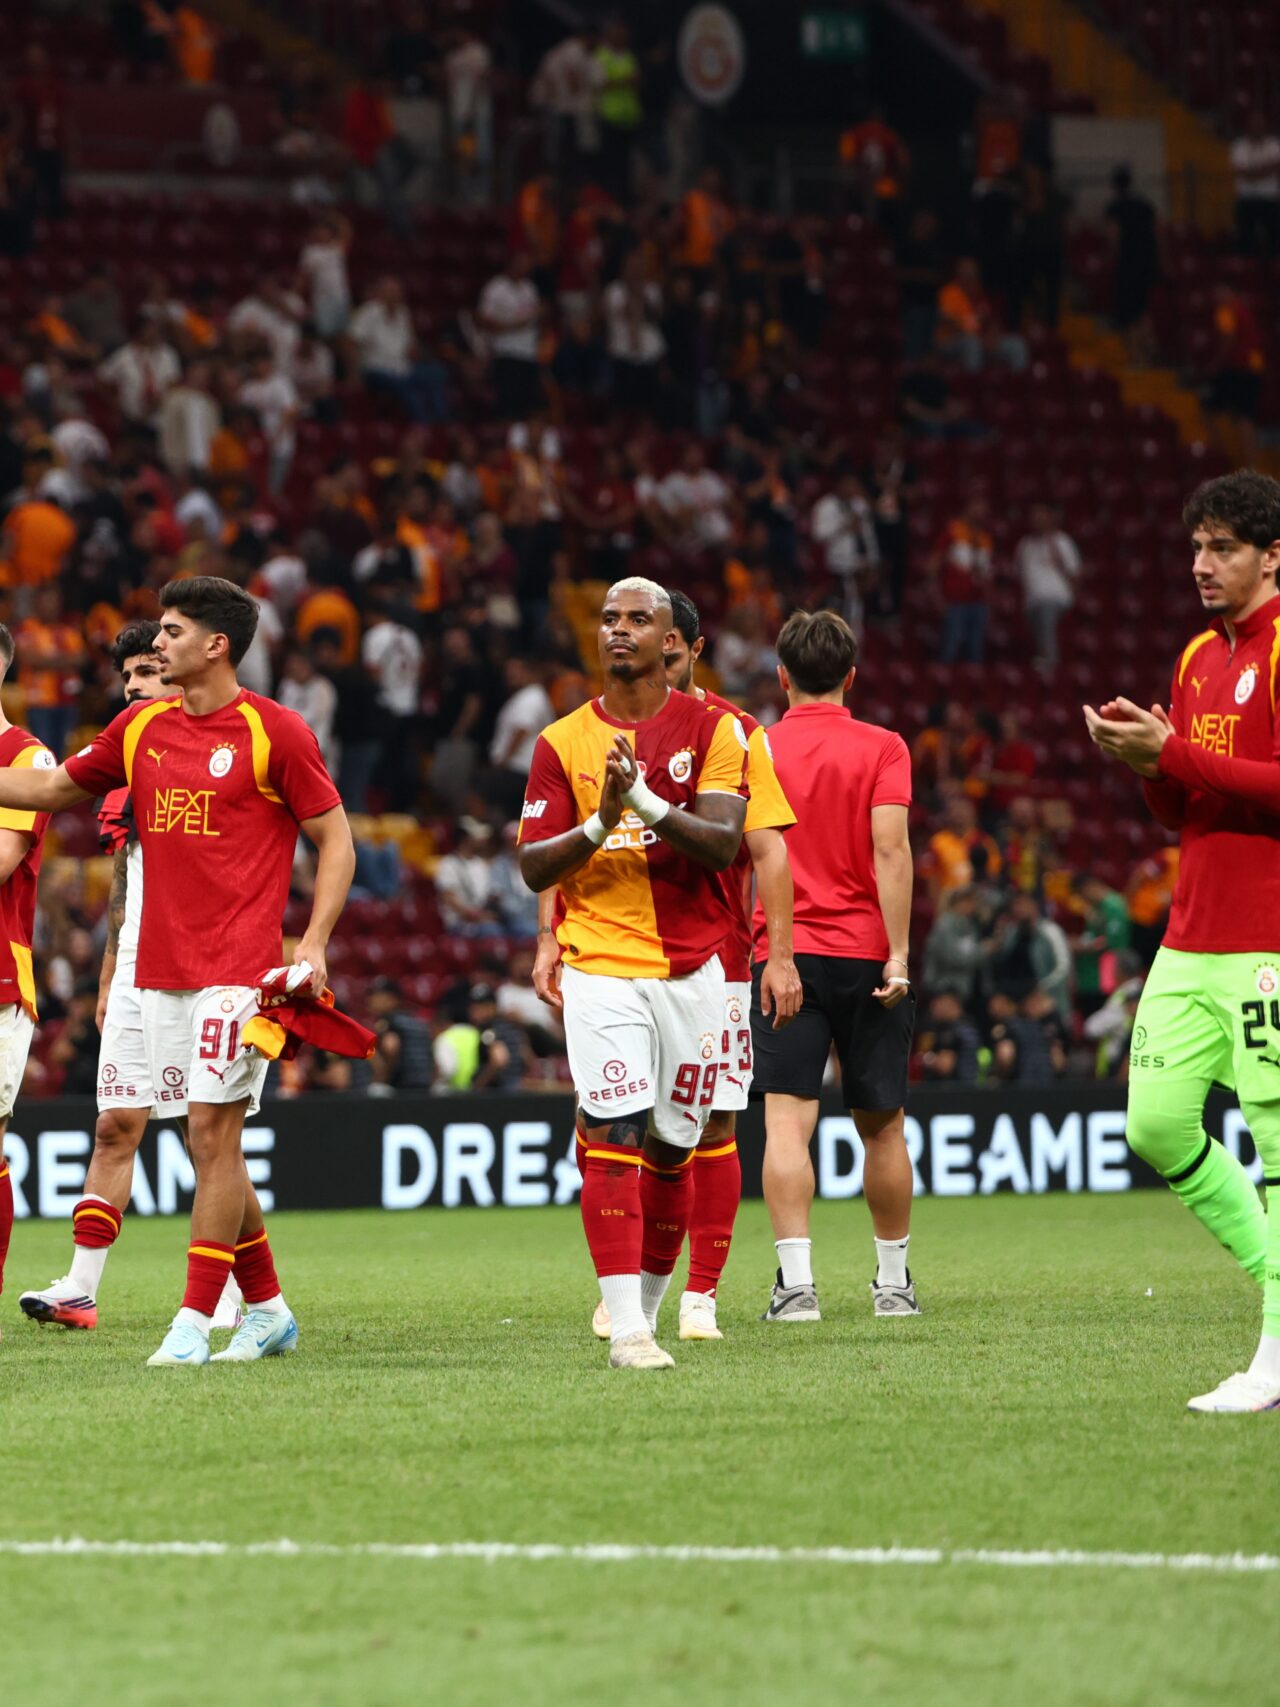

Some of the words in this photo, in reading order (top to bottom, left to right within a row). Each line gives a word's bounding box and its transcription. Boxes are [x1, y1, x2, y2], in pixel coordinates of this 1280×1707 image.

[1190, 712, 1241, 739] NEXT
[155, 787, 217, 813] NEXT
[147, 809, 220, 836] LEVEL
[200, 1018, 239, 1062] 91
[589, 1078, 649, 1102] REGES
[671, 1063, 719, 1106] 99
